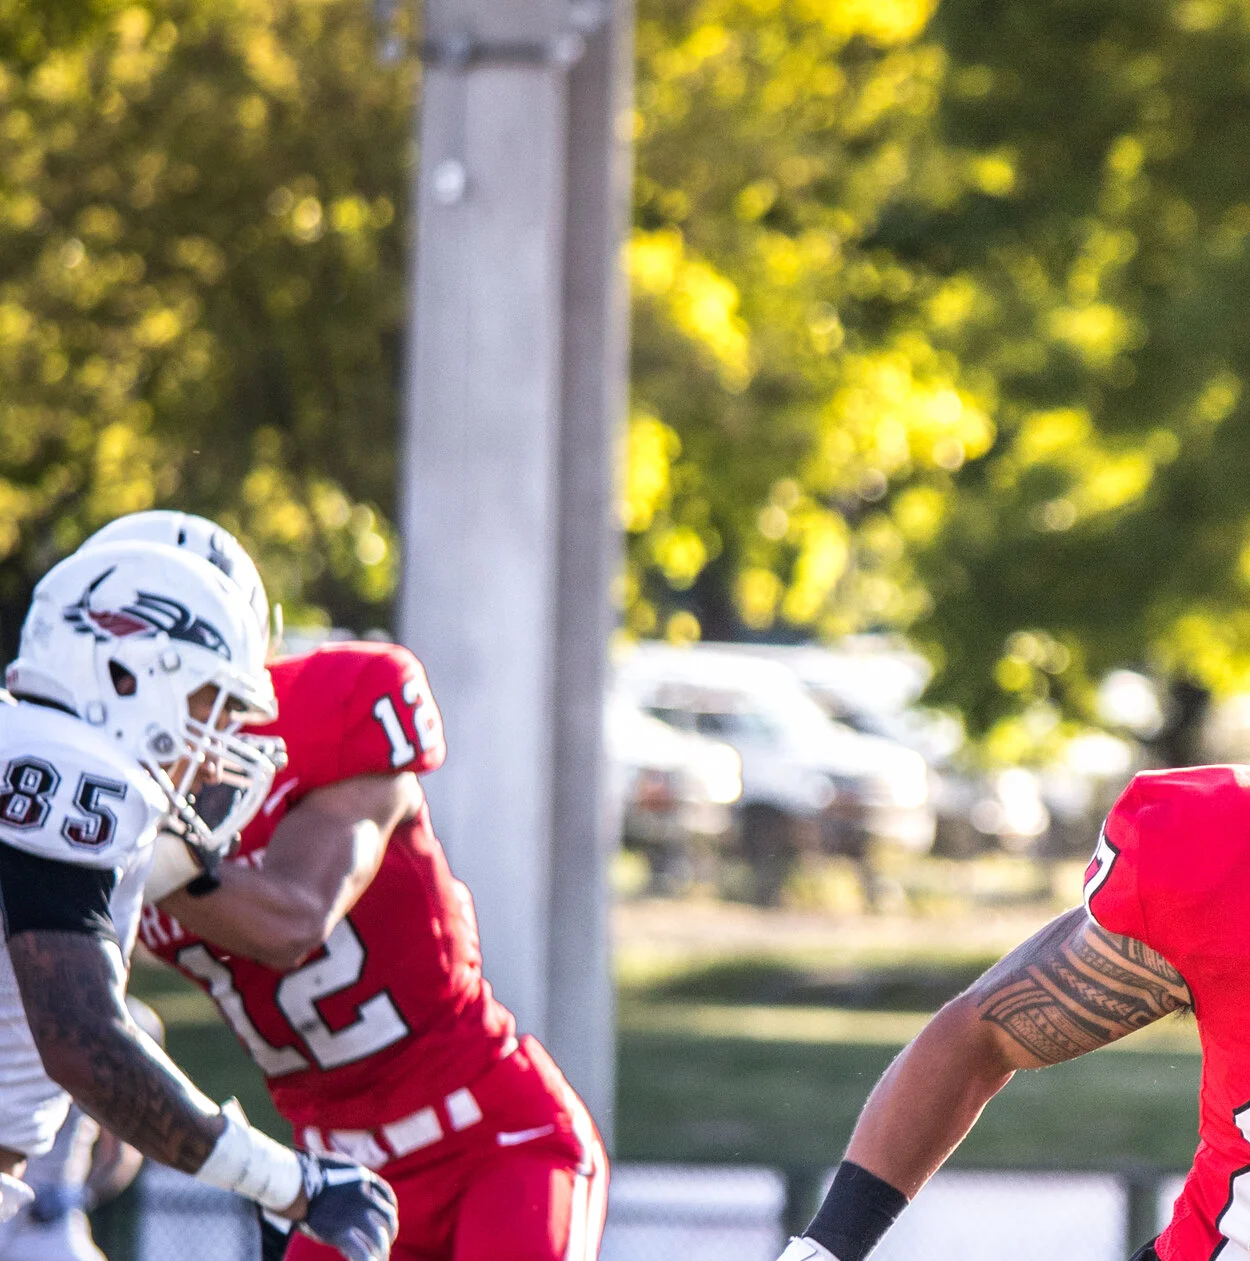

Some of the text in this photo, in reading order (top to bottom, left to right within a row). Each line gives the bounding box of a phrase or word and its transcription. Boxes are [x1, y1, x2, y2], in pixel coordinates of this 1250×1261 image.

[373, 678, 444, 769] 12
[0, 755, 127, 854] 85
[176, 913, 411, 1077] 12
